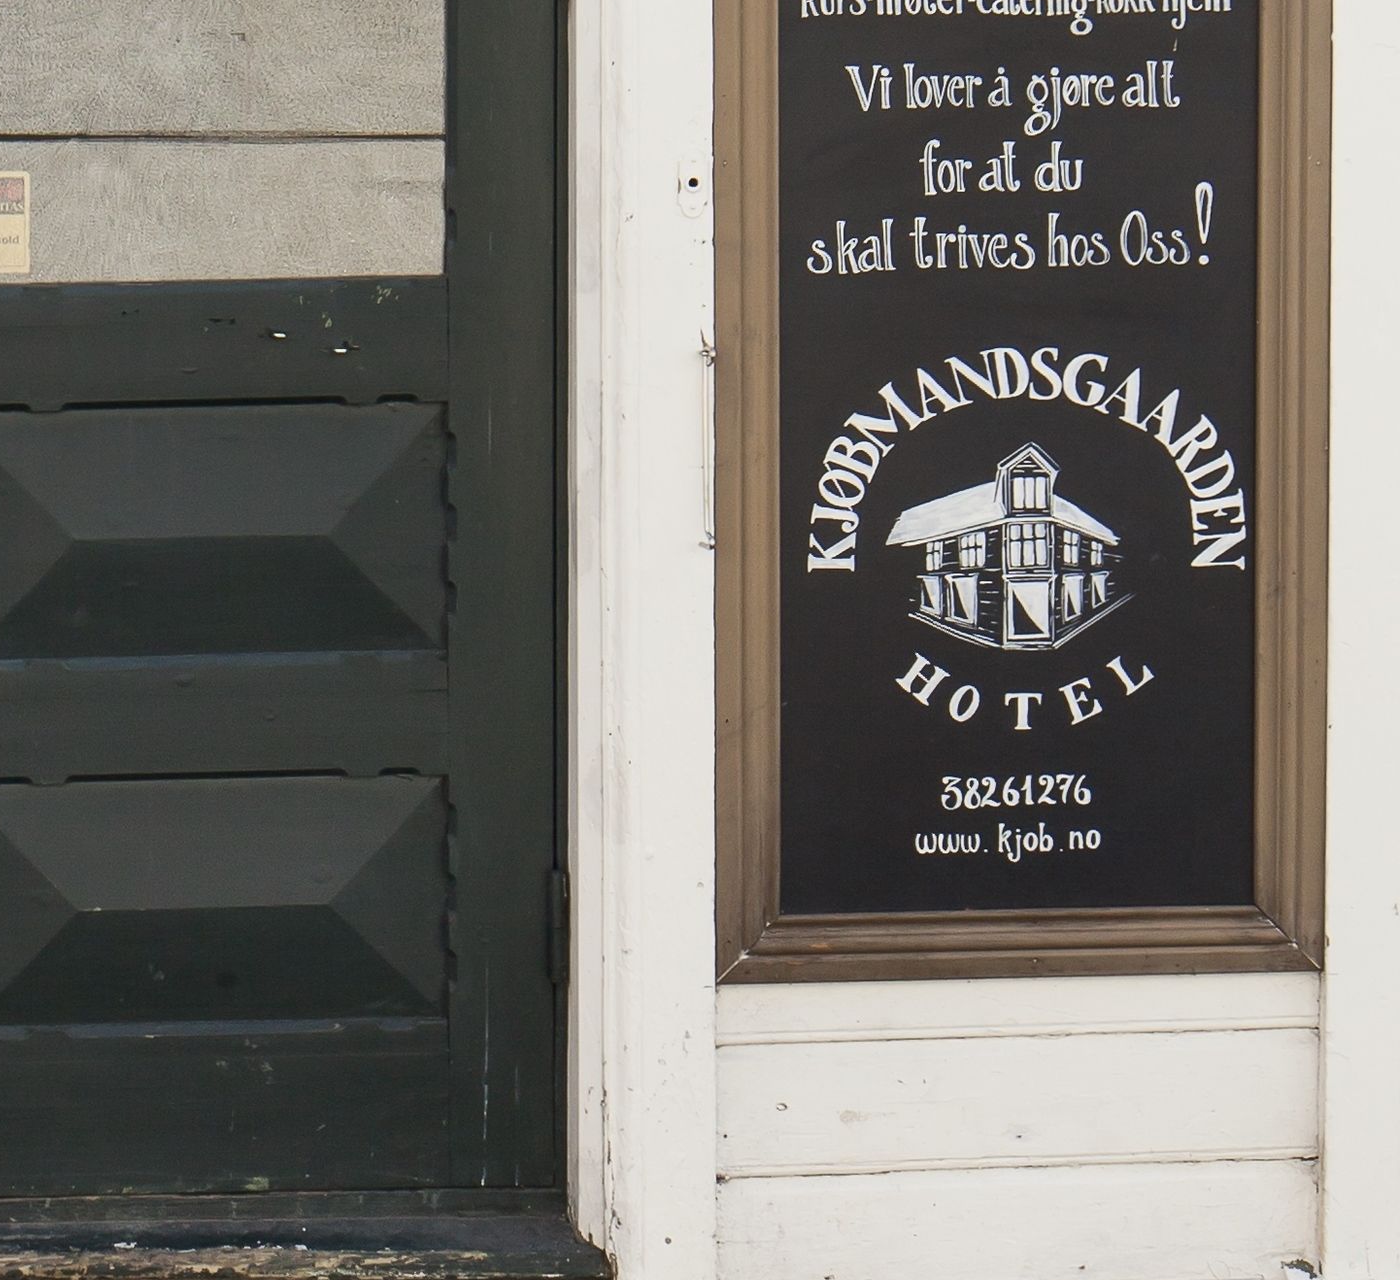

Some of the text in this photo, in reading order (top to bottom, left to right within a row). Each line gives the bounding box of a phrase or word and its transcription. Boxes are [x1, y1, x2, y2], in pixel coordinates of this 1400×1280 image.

[845, 60, 1181, 136] Vi lover å gjøre alt
[919, 138, 1084, 195] for at du
[806, 181, 1214, 275] skal trives hos Oss!
[807, 347, 1247, 573] KJØBMANDSGAARDEN
[896, 652, 1155, 731] HOTEL
[940, 773, 1092, 811] 38261276
